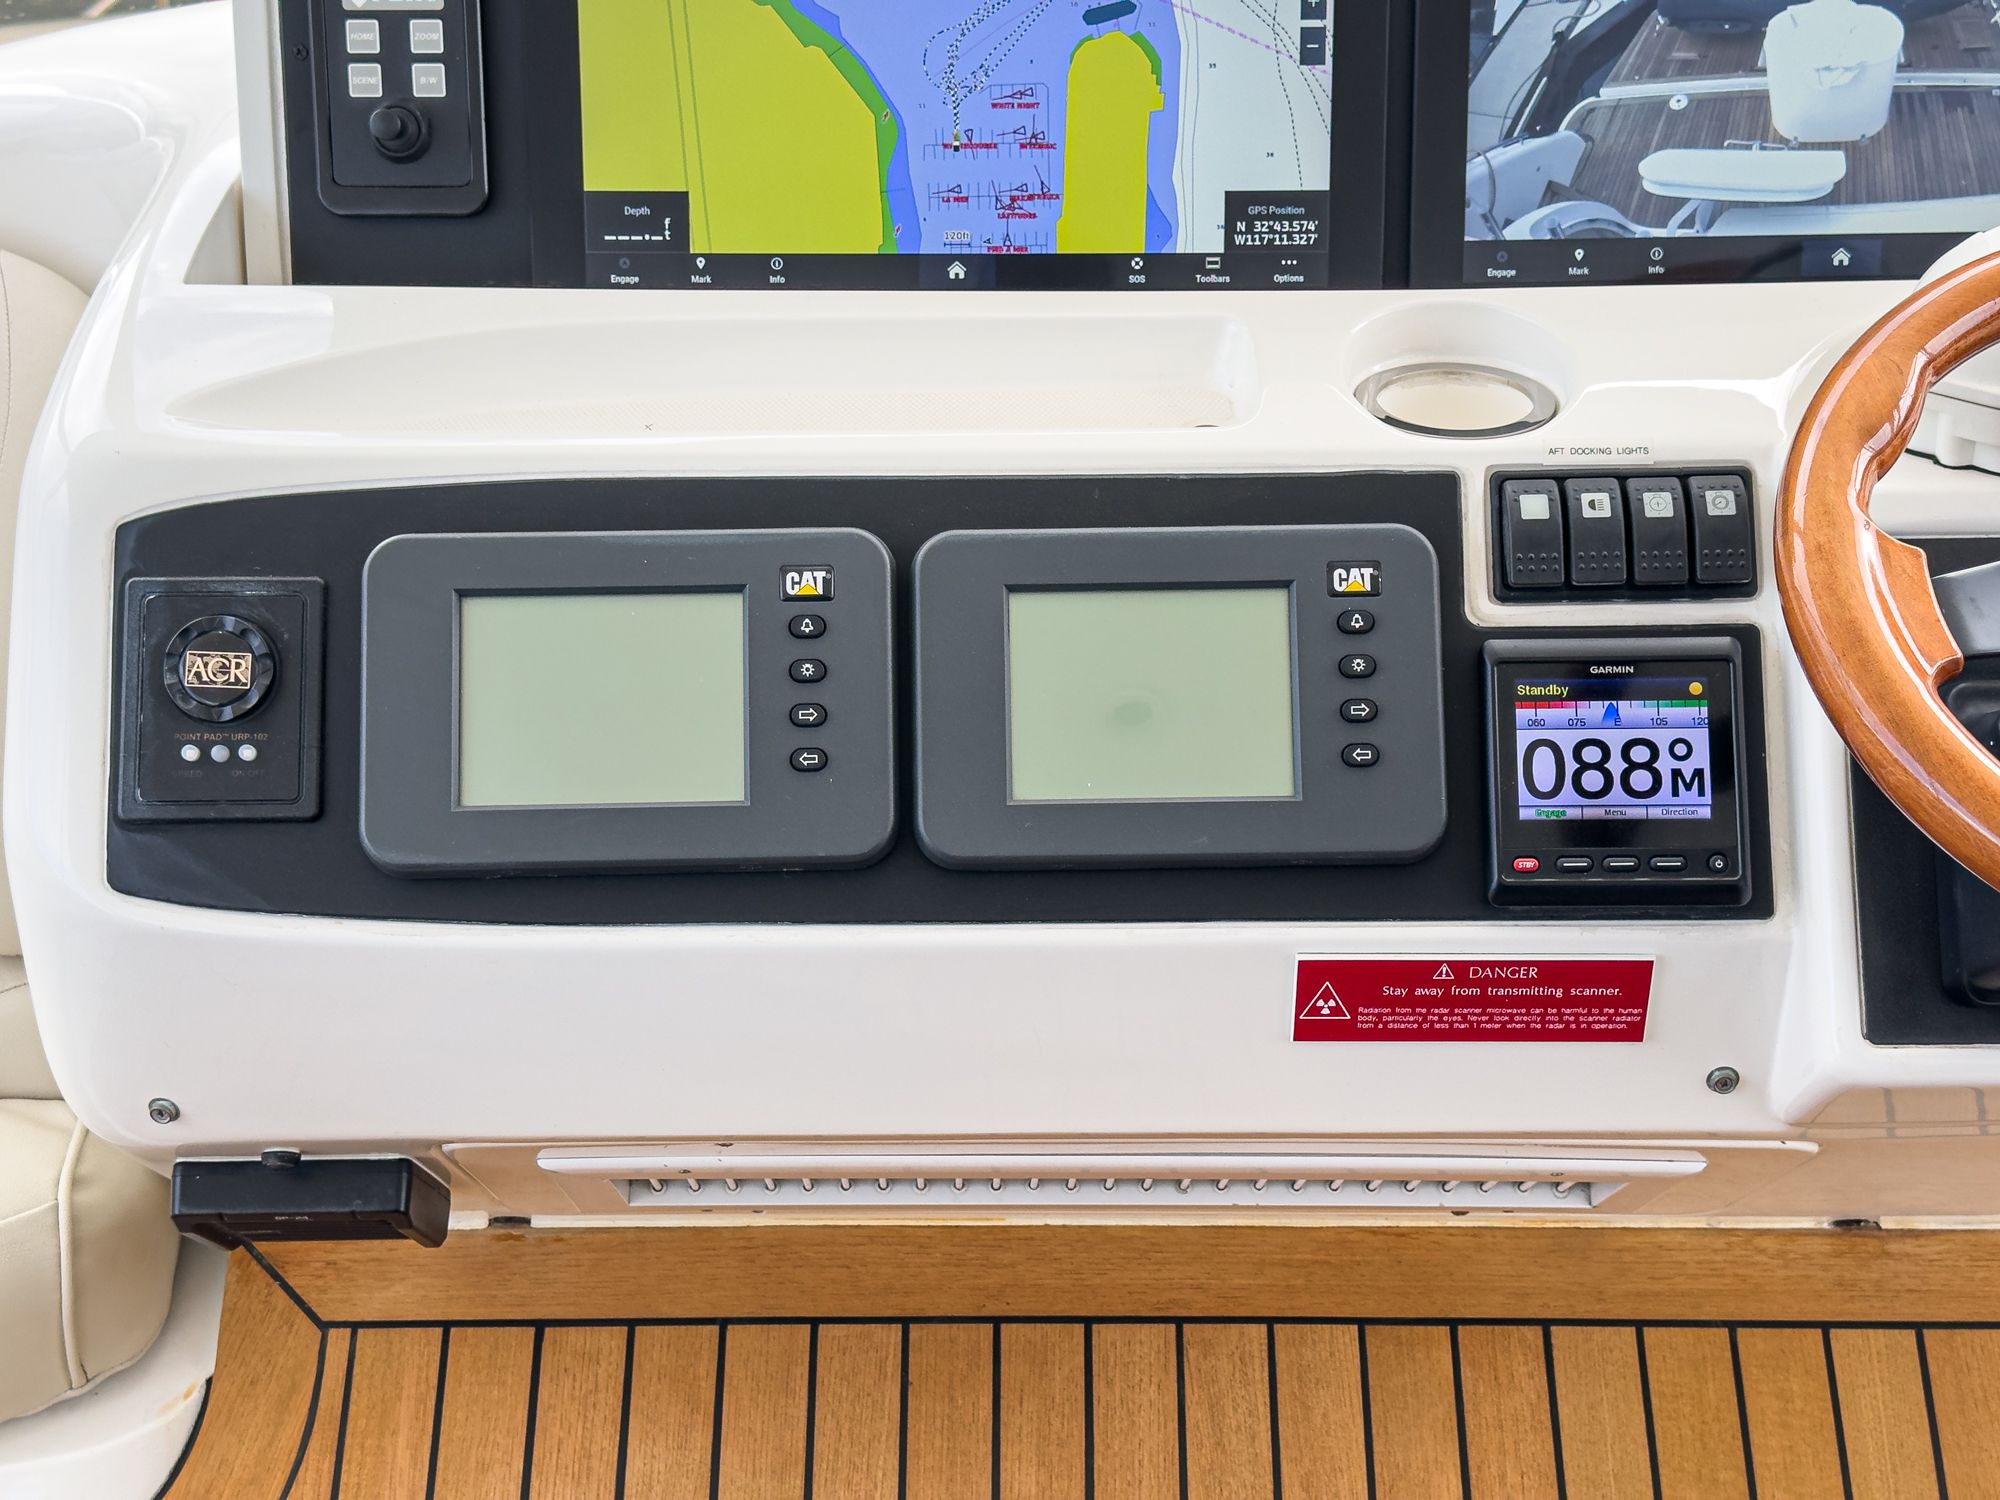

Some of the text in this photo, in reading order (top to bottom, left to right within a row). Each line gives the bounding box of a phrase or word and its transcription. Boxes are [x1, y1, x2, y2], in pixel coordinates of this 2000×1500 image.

[624, 206, 651, 217] Depth
[1248, 206, 1305, 215] GPS Position
[1236, 221, 1246, 232] N
[1487, 268, 1517, 279] Engage
[1568, 266, 1589, 276] Mark
[1648, 265, 1665, 275] Info
[610, 274, 640, 286] Engage
[691, 275, 712, 284] Mark
[769, 275, 786, 284] Info
[1128, 274, 1146, 283] SOS
[1196, 274, 1230, 283] Toolbars
[1273, 274, 1304, 285] Options
[1548, 446, 1649, 456] AFT DOCKING LIGHTS
[785, 570, 824, 596] CAT
[1333, 567, 1374, 592] CAT
[187, 657, 248, 683] ACR
[1590, 665, 1634, 674] GARMIN
[1517, 684, 1569, 698] Standby
[1527, 718, 1546, 727] 060
[1567, 718, 1586, 727] 075
[1614, 717, 1621, 727] E
[1650, 717, 1668, 726] 105
[1604, 808, 1627, 816] Menu
[1661, 807, 1698, 816] Direction
[1518, 860, 1535, 868] STBY
[1469, 966, 1538, 979] DANGER
[1382, 985, 1622, 998] Stay away from transmitting scanner.
[1591, 1022, 1628, 1030] operation.
